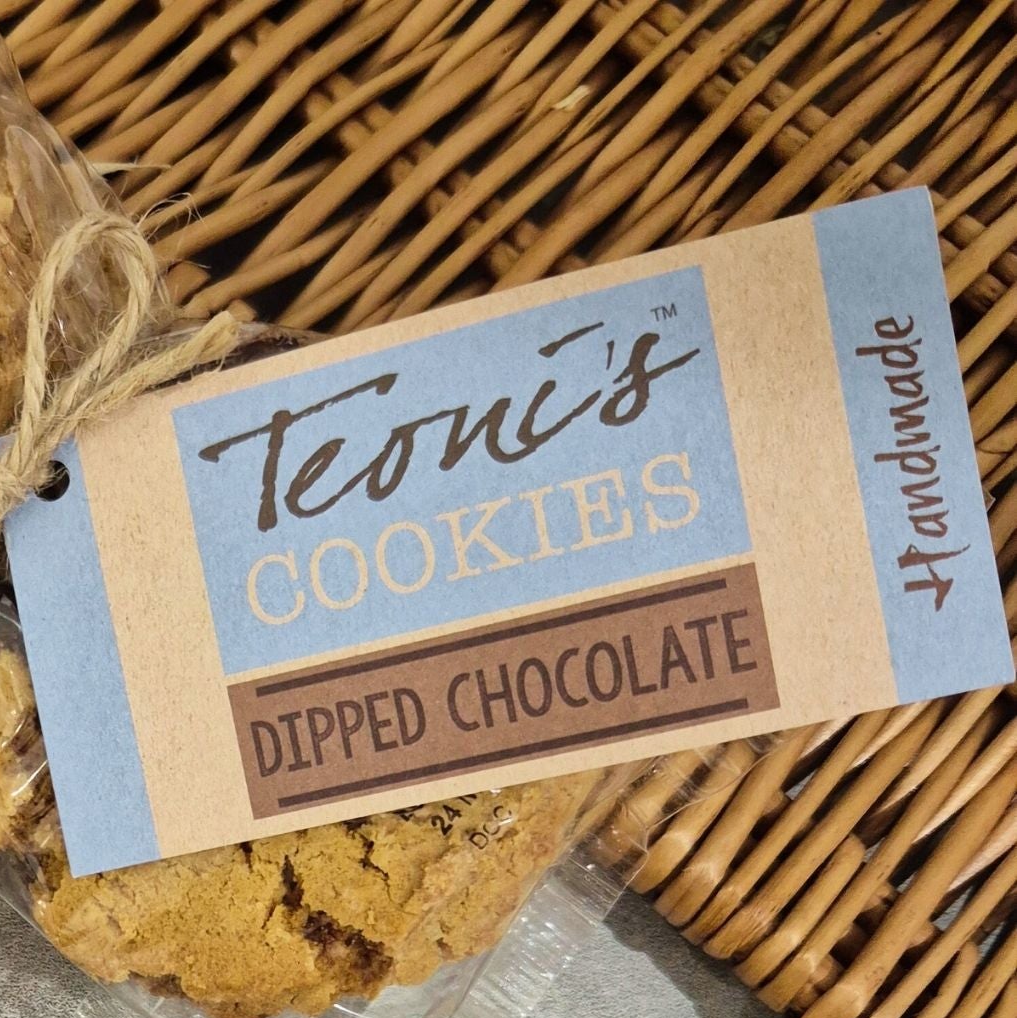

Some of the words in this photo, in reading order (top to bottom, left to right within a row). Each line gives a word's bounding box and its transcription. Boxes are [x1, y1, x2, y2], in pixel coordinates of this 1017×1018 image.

[199, 321, 700, 532] Teoni's
[855, 315, 972, 612] Handmade
[245, 454, 704, 627] COOKIES
[250, 687, 428, 778] DIPPED
[447, 609, 758, 733] CHOCOLATE
[431, 803, 464, 837] 24
